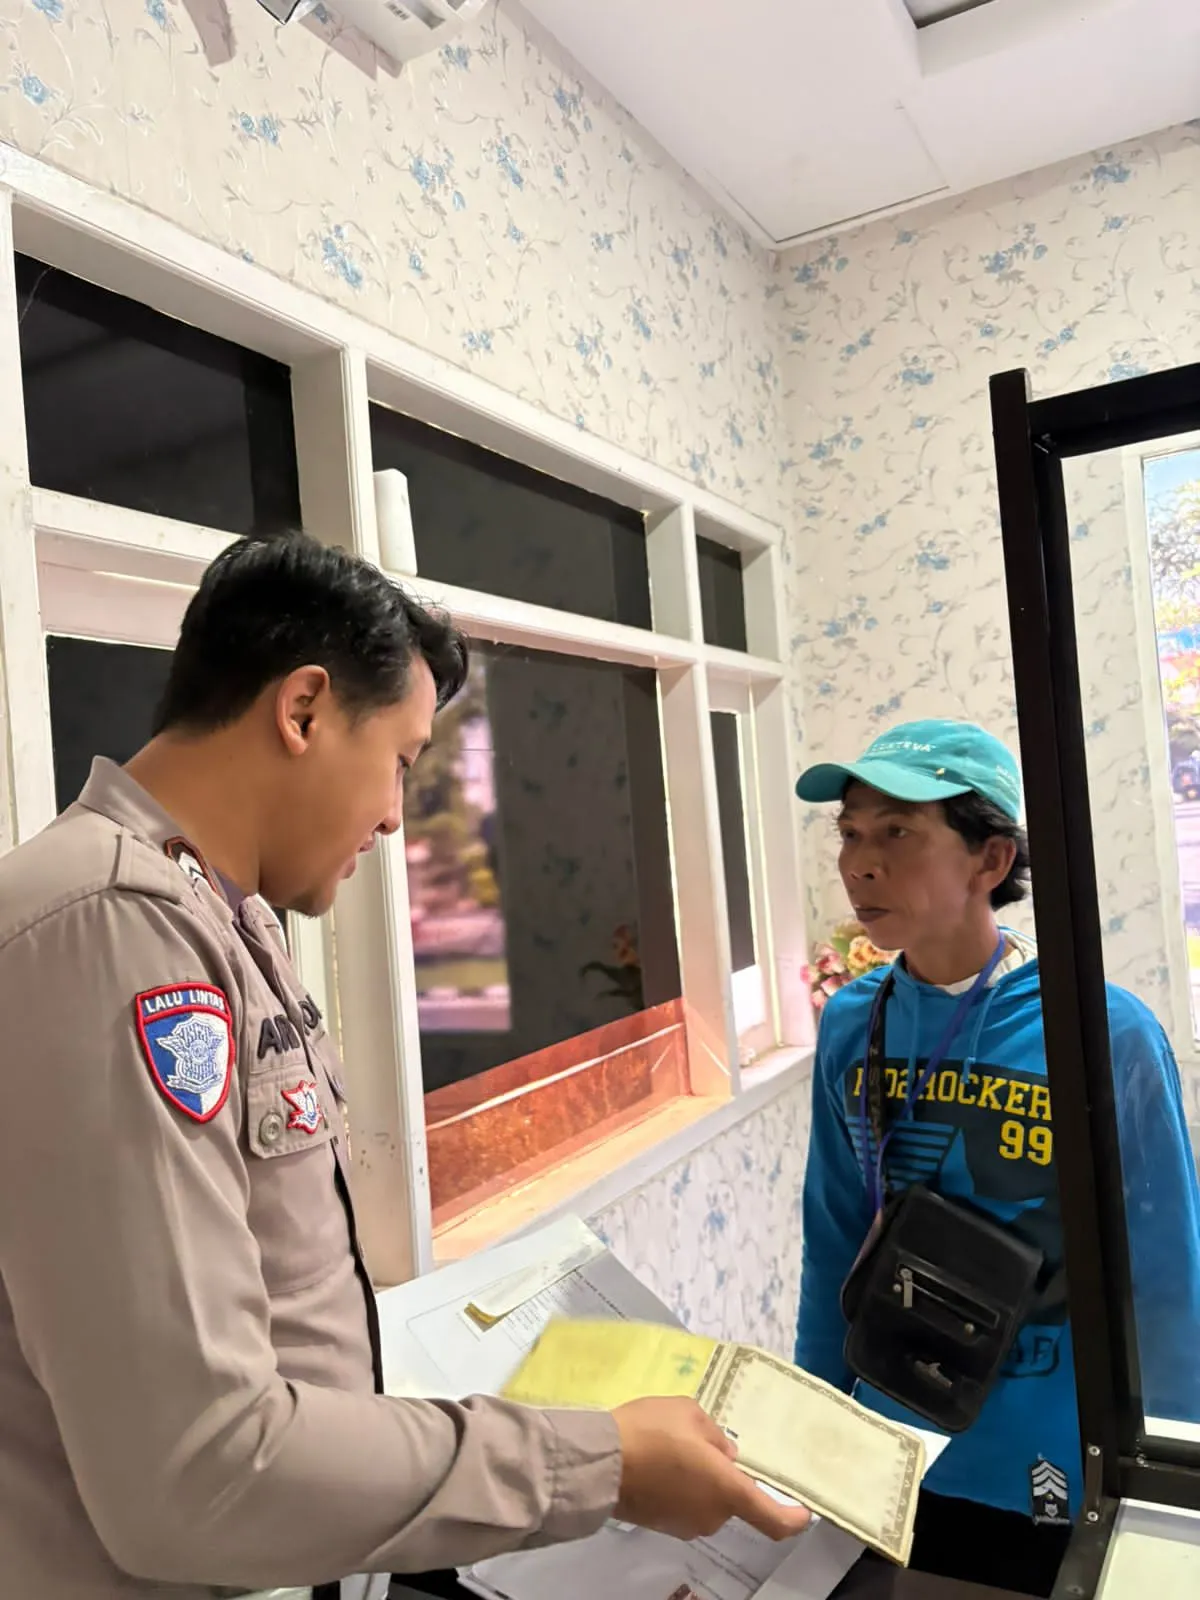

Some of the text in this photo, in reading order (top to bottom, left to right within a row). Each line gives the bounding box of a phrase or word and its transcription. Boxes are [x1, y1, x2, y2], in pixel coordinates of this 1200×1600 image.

[145, 990, 225, 1013] LALU LINTAS
[999, 1119, 1053, 1166] 99
